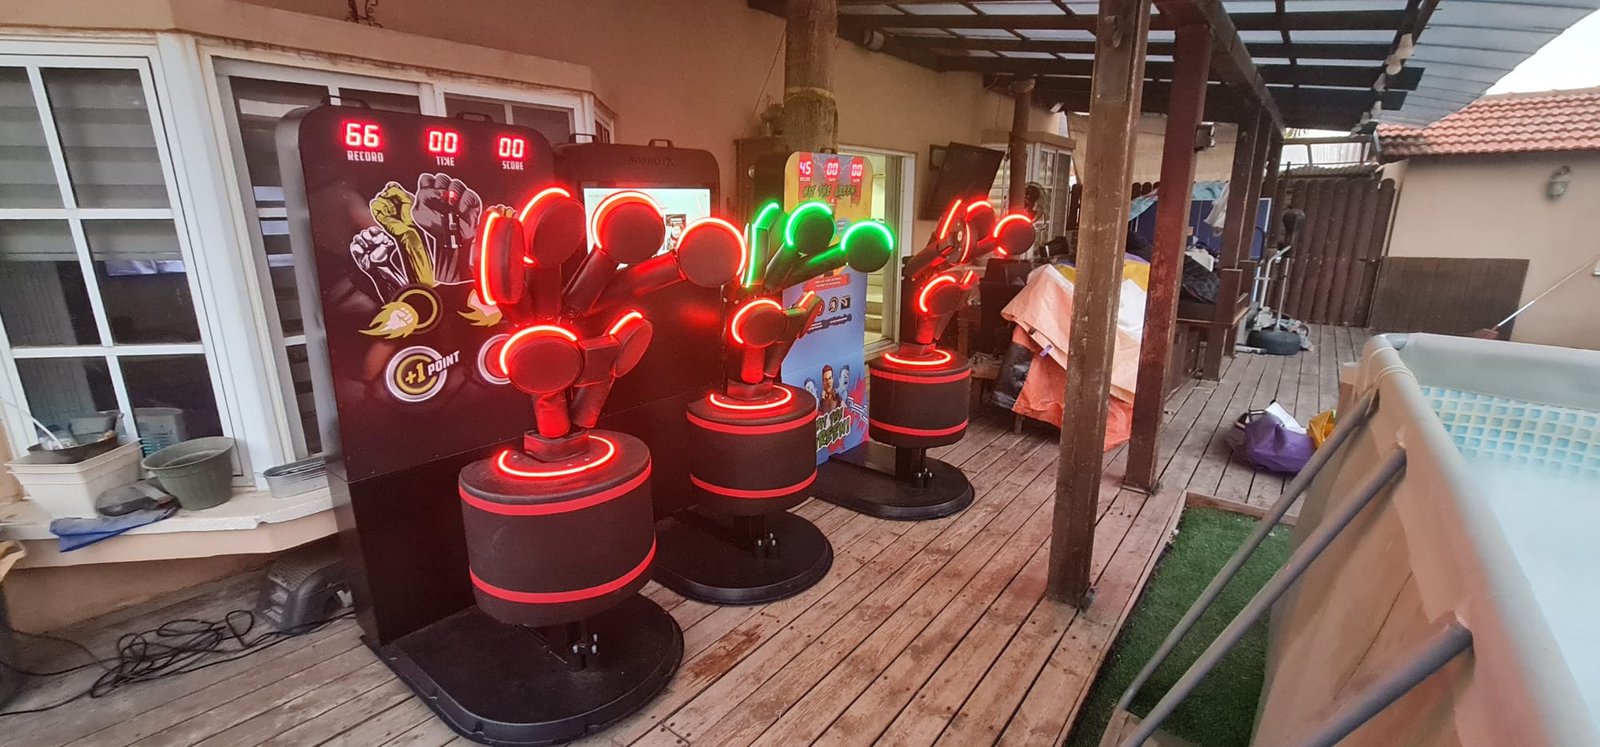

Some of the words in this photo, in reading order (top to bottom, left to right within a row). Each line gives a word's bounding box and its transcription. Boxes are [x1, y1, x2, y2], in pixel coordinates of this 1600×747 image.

[345, 123, 380, 147] 66
[428, 131, 458, 153] 00
[498, 137, 525, 158] 00
[347, 150, 384, 163] RECORD
[501, 160, 524, 171] SCORE
[800, 161, 811, 175] 45
[826, 163, 839, 176] 00
[851, 164, 863, 177] 00
[405, 362, 426, 384] +1
[427, 351, 460, 376] POINT
